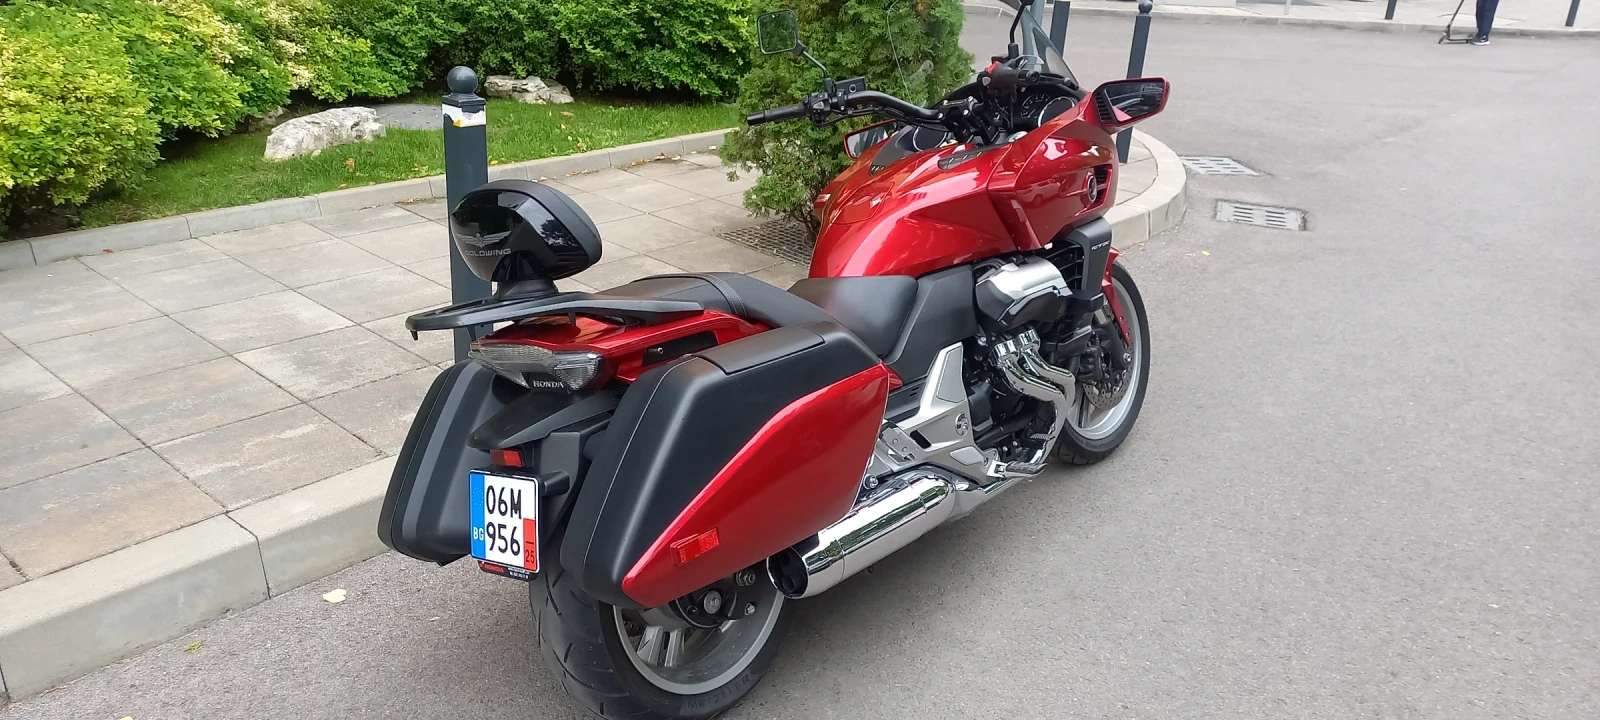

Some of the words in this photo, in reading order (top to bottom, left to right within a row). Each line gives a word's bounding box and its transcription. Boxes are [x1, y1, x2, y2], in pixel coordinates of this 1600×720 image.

[465, 248, 512, 257] GOLDWING
[532, 380, 565, 388] HONDA
[486, 485, 522, 520] 06M
[473, 527, 484, 540] BG
[486, 521, 521, 556] 956
[525, 550, 535, 563] 25
